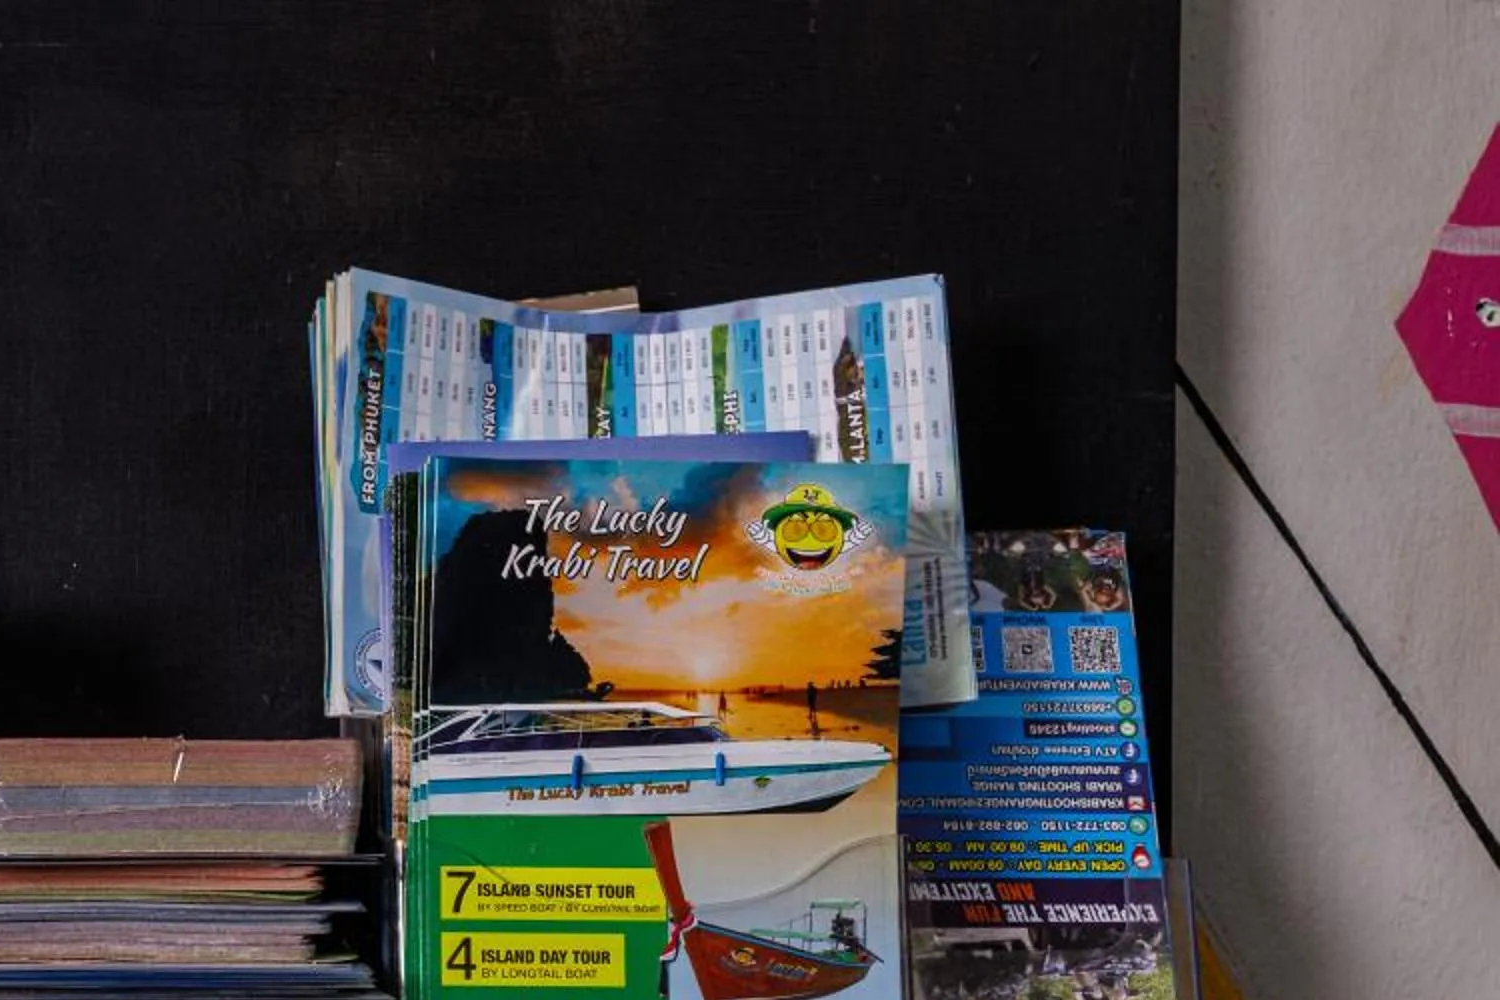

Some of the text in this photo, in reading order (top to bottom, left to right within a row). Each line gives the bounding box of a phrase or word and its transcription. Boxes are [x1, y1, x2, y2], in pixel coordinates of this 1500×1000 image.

[483, 384, 497, 442] NANG
[596, 407, 611, 440] LAY
[361, 368, 382, 505] FROM PHUKET
[525, 496, 688, 547] The Lucky
[501, 541, 709, 581] Krabi Travel
[508, 780, 691, 801] The Lucky Krabi Travel
[1038, 842, 1068, 853] TIME
[1073, 842, 1089, 853] UP
[1094, 842, 1124, 853] PICK
[1017, 860, 1042, 871] DAY
[1046, 860, 1086, 871] EVERY
[1091, 860, 1125, 871] OPEN
[446, 871, 636, 913] 7 ISLAND SUNSET TOUR
[909, 882, 1036, 901] AND EXCITEM
[1004, 903, 1046, 923] THE
[1047, 903, 1159, 923] EXPERIENCE
[446, 936, 611, 980] 4 ISLAND DAY TOUR
[481, 968, 598, 979] BY LONGTAIL BOAT
